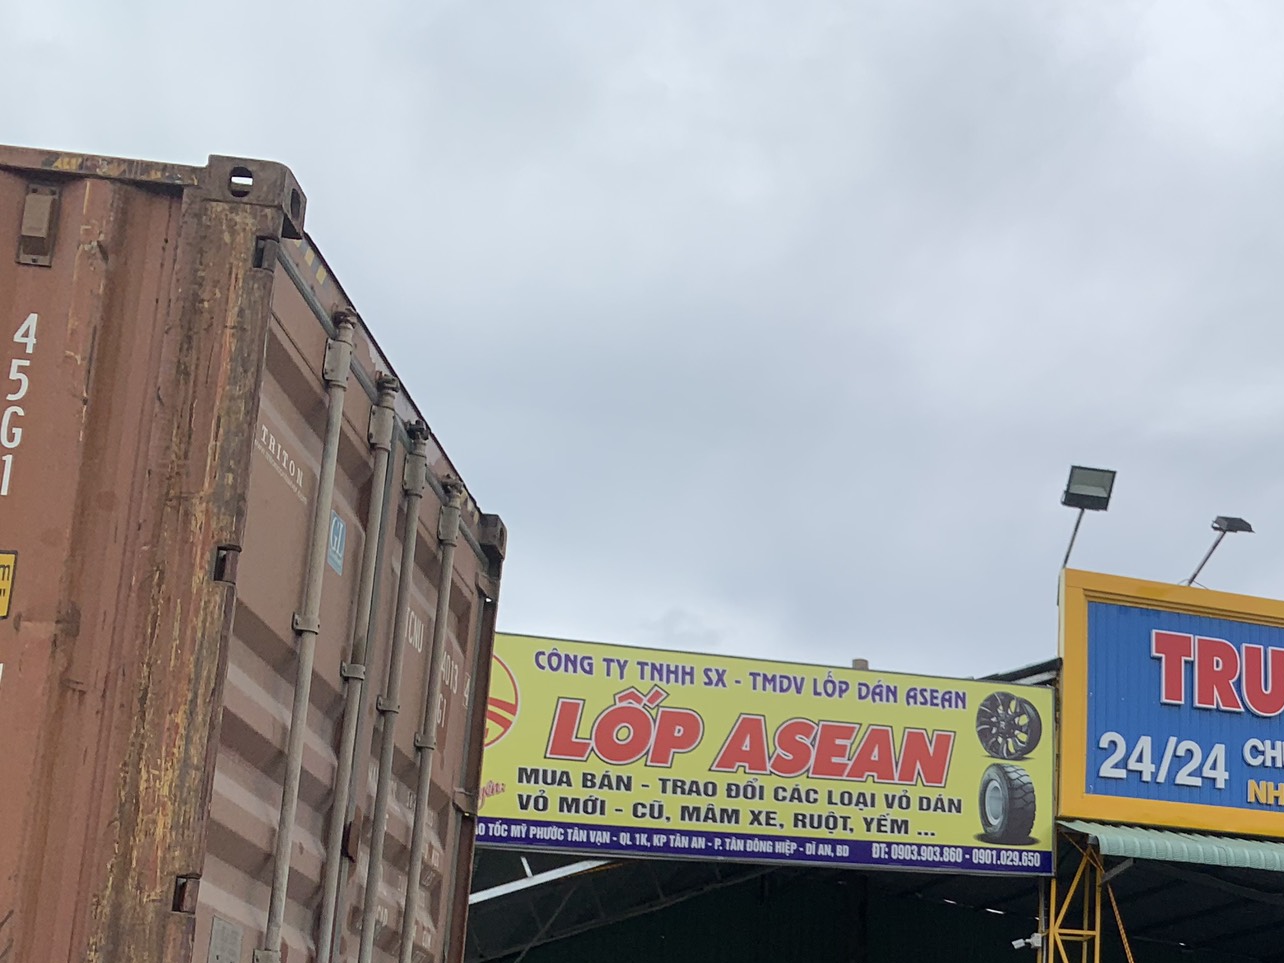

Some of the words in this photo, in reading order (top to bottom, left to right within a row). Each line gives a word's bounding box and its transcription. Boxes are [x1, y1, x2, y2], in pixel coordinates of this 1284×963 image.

[261, 424, 304, 488] TRITON
[330, 516, 344, 558] GL
[534, 648, 594, 675] CÔNG
[603, 658, 629, 680] TY
[637, 661, 695, 686] TNHH
[703, 667, 727, 688] SX
[749, 672, 805, 694] TMDV
[813, 671, 850, 698] LỐP
[858, 680, 898, 704] DÁN
[905, 687, 967, 710] ASEAN
[544, 684, 705, 769] LỐP
[709, 713, 956, 788] ASEAN
[1098, 731, 1229, 789] 24/24
[517, 767, 572, 788] MUA
[581, 771, 632, 792] BÁN
[658, 778, 717, 797] TRAO
[726, 778, 764, 800] ĐỔI
[773, 784, 819, 804] CÁC
[827, 790, 876, 811] LOẠI
[884, 789, 911, 811] VỎ
[918, 794, 963, 814] DÁN
[517, 789, 549, 812] VỎ
[558, 795, 606, 816] MỚI
[632, 800, 671, 823] CŨ,
[680, 803, 740, 825] MÂM
[749, 810, 784, 829] XE,
[793, 811, 854, 834] RUỘT,
[863, 813, 909, 835] YẾM
[488, 820, 508, 837] TỐC
[511, 824, 527, 838] MỸ
[529, 825, 564, 841] PHƯỚC
[567, 827, 587, 842] TÂN
[589, 831, 610, 845] VẠN
[619, 832, 632, 846] QL
[653, 834, 667, 847] KP
[669, 833, 689, 848] TÂN
[691, 837, 706, 849] AN
[725, 837, 744, 851] TÂN
[746, 838, 773, 853] ĐÔNG
[775, 840, 797, 856] HIỆP
[817, 844, 834, 857] AN,
[836, 845, 849, 857] BD
[871, 843, 888, 859] ĐT:
[891, 843, 963, 863] 0903.903.860
[972, 848, 1041, 867] 0901.029.650
